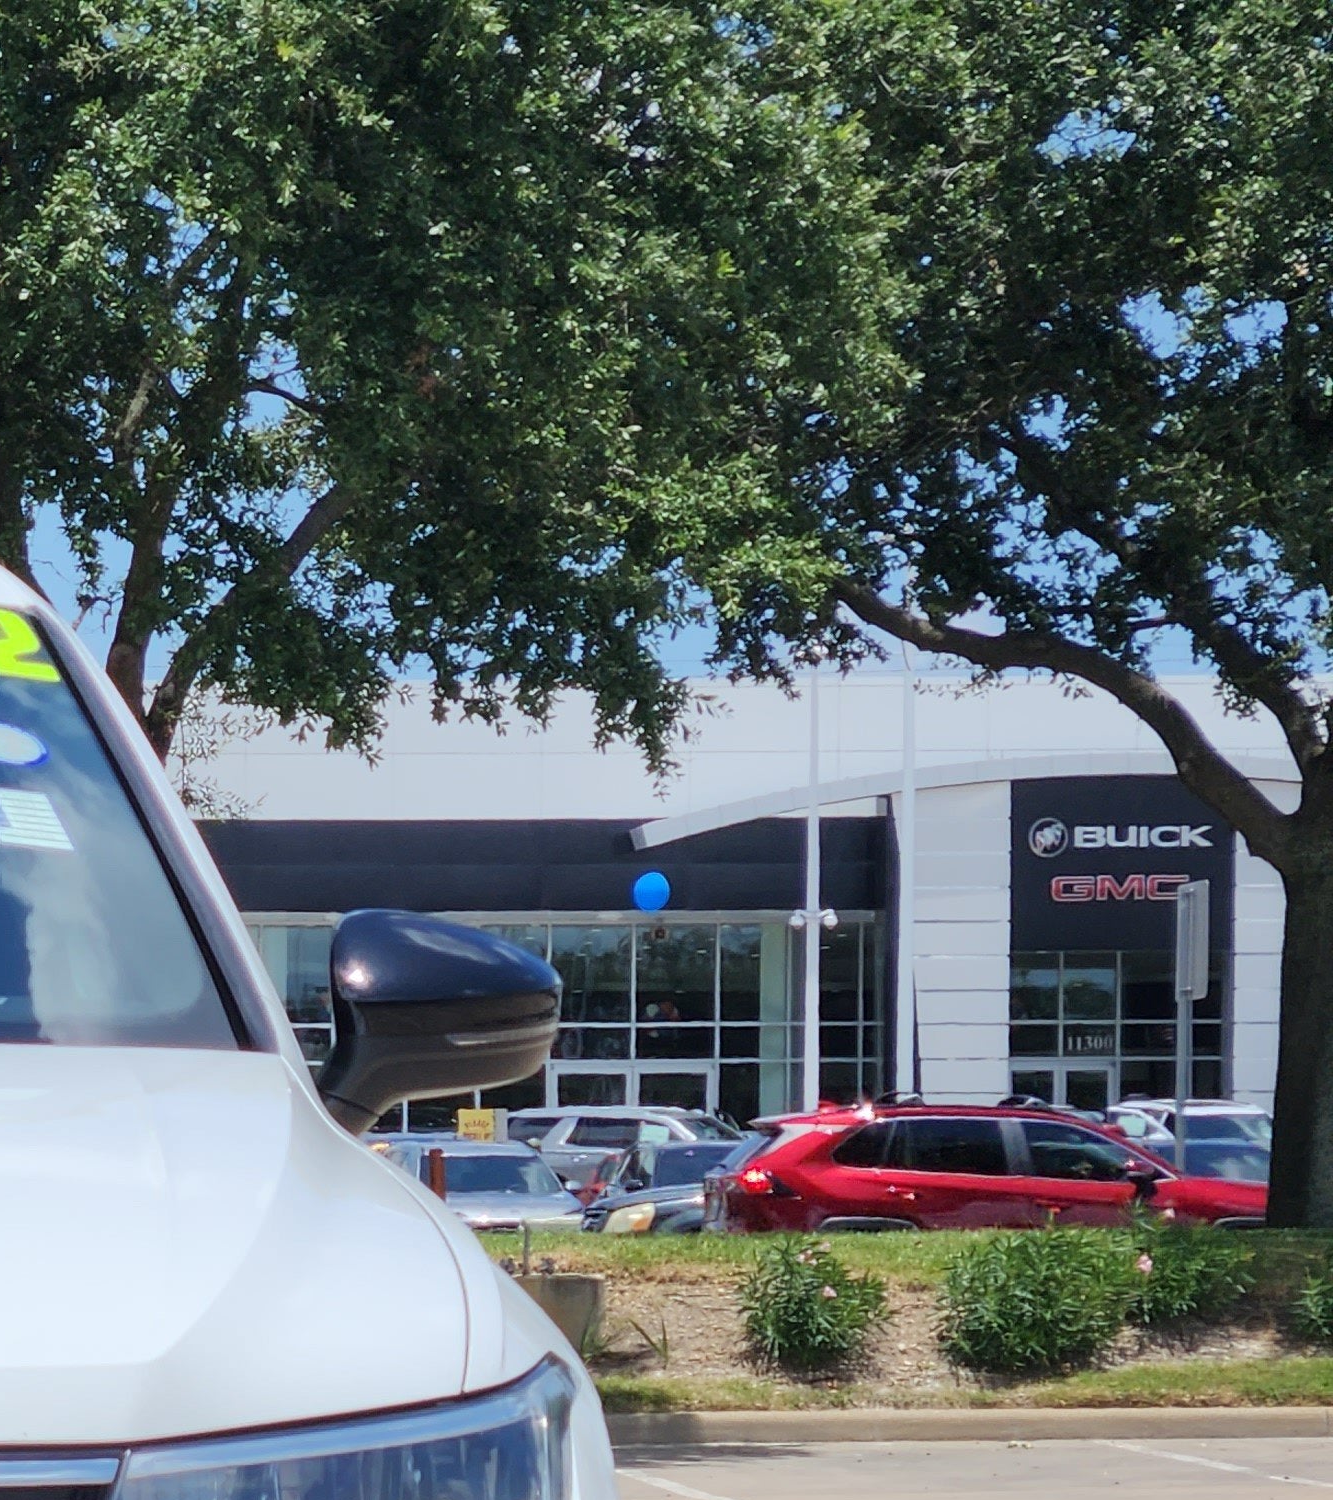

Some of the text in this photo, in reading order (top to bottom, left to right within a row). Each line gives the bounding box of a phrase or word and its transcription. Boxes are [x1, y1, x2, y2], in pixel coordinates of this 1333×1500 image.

[1073, 825, 1214, 849] BUICK
[1050, 874, 1190, 902] GMC
[1066, 1035, 1114, 1051] 11300
